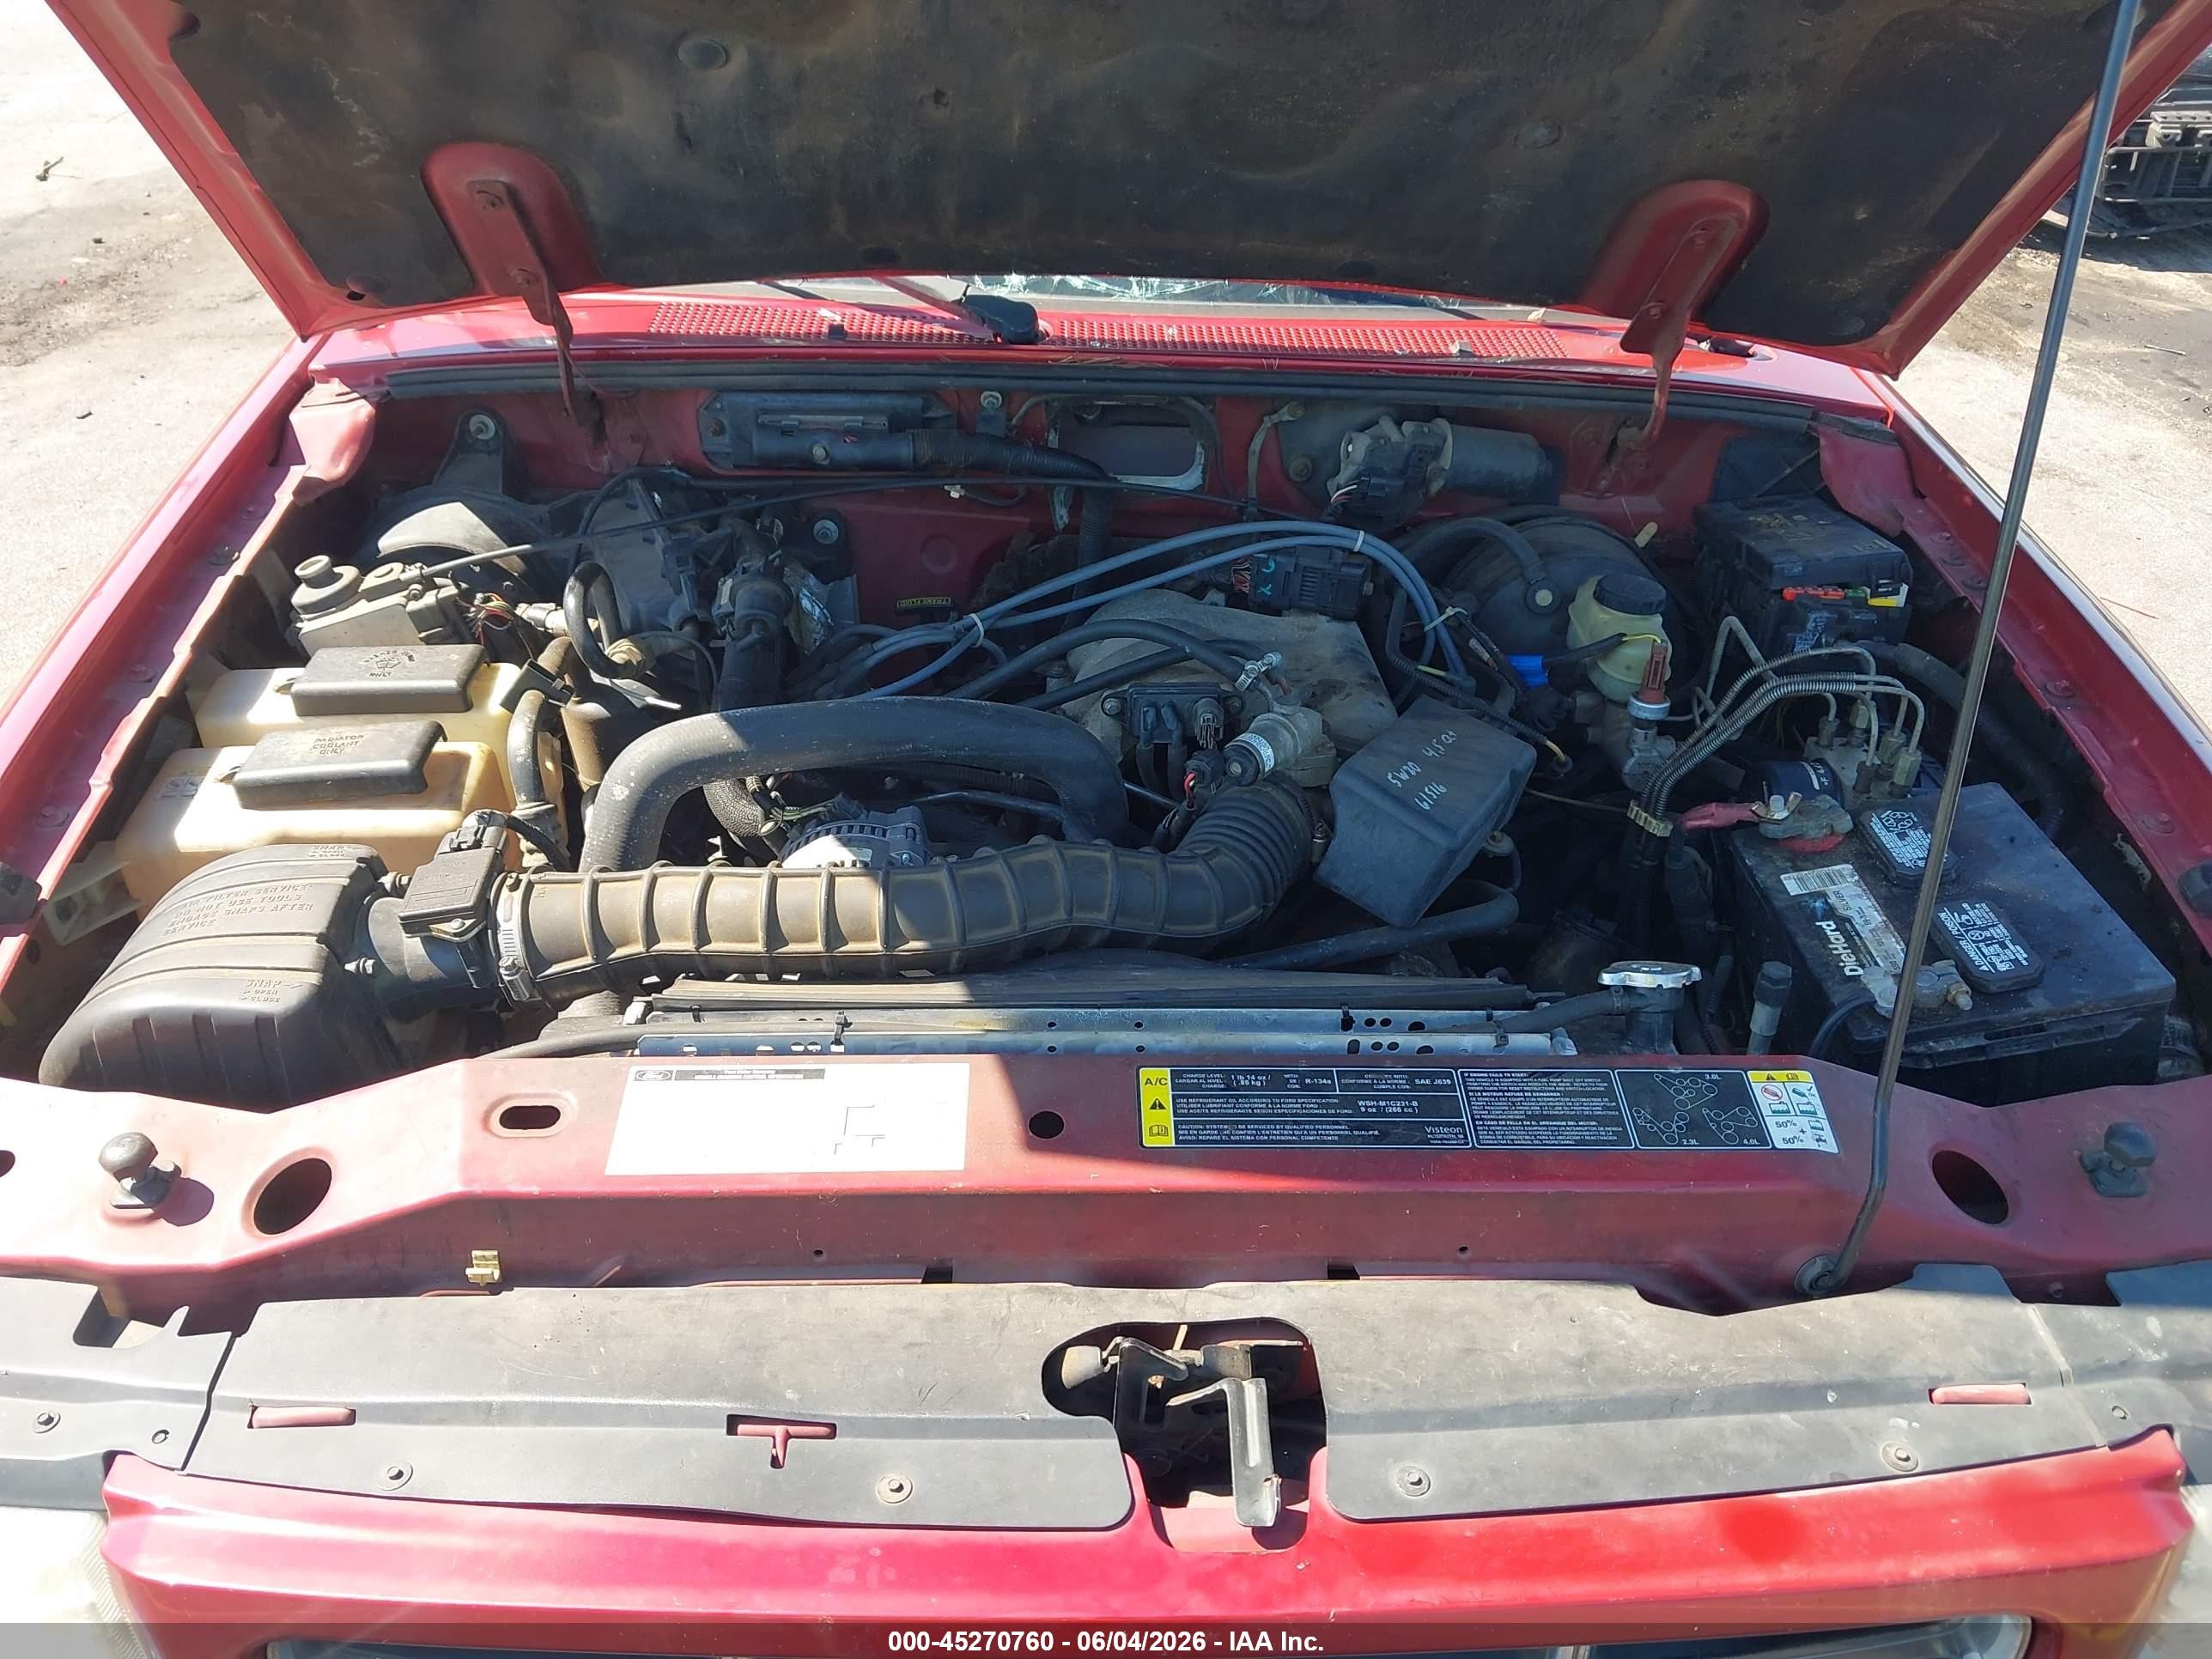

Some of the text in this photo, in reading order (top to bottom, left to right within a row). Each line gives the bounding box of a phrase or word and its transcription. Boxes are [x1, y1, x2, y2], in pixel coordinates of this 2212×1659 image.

[313, 740, 361, 750] COOLANT
[314, 734, 365, 744] RADIATOR
[206, 890, 249, 902] FILTER
[1832, 890, 1853, 912] SILVER
[195, 902, 221, 913] NOT
[228, 896, 252, 907] USE
[260, 894, 303, 902] TOOLS
[224, 905, 265, 917] SNAPS
[270, 903, 314, 913] AFTER
[161, 919, 217, 937] SERVICE
[1938, 912, 1962, 936] POISON
[1814, 921, 1865, 976] DieHard
[1959, 939, 1985, 967] DANGER
[246, 979, 283, 988] SNAP
[1144, 1078, 1169, 1087] A/C
[1775, 1119, 1797, 1129] 50%
[1782, 1135, 1805, 1145] 50%
